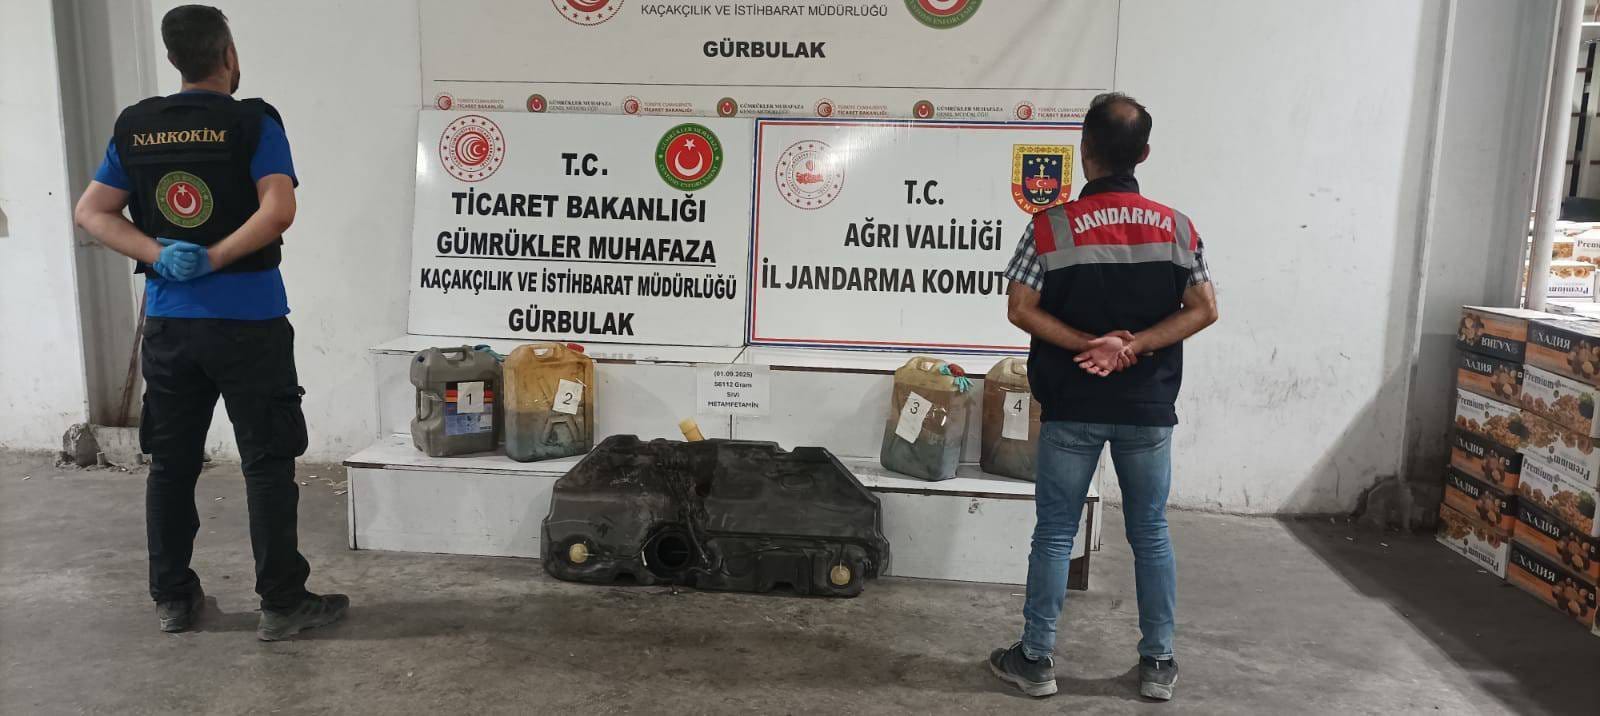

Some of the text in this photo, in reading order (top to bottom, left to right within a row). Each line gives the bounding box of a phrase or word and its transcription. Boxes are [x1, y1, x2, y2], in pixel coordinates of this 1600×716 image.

[640, 5, 711, 19] KAÇAKÇILIK
[715, 5, 731, 16] VE
[734, 3, 806, 17] İSTİHBARAT
[809, 3, 889, 17] MÜDÜRLÜĞÜ
[703, 38, 827, 59] GÜRBULAK
[133, 128, 227, 146] NARKOKİM
[561, 153, 608, 177] T.C.
[904, 180, 944, 205] T.C.
[451, 187, 706, 223] TİCARET BAKANLIĞI
[1073, 206, 1172, 234] JANDARMA
[436, 227, 717, 264] GÜMRÜKLER MUHAFAZA
[843, 217, 1003, 251] AĞRI VALİLİĞİ
[420, 268, 737, 300] KAÇAKÇILIK VE İSTİHBARAT MÜDÜRLÜĞÜ
[761, 257, 1009, 297] İL JANDARMA KOMUT
[508, 304, 635, 336] GÜRBULAK
[1537, 332, 1571, 350] ХАДИЯ
[1465, 359, 1492, 374] ХАДИЯ
[1524, 370, 1555, 390] Premium
[466, 393, 472, 405] 1
[563, 392, 573, 405] 2
[910, 401, 920, 415] 3
[1013, 399, 1022, 412] 4
[1522, 459, 1553, 483] Premium
[1526, 511, 1560, 537] ХАДИЯ
[1519, 554, 1555, 582] ХАДИЯ
